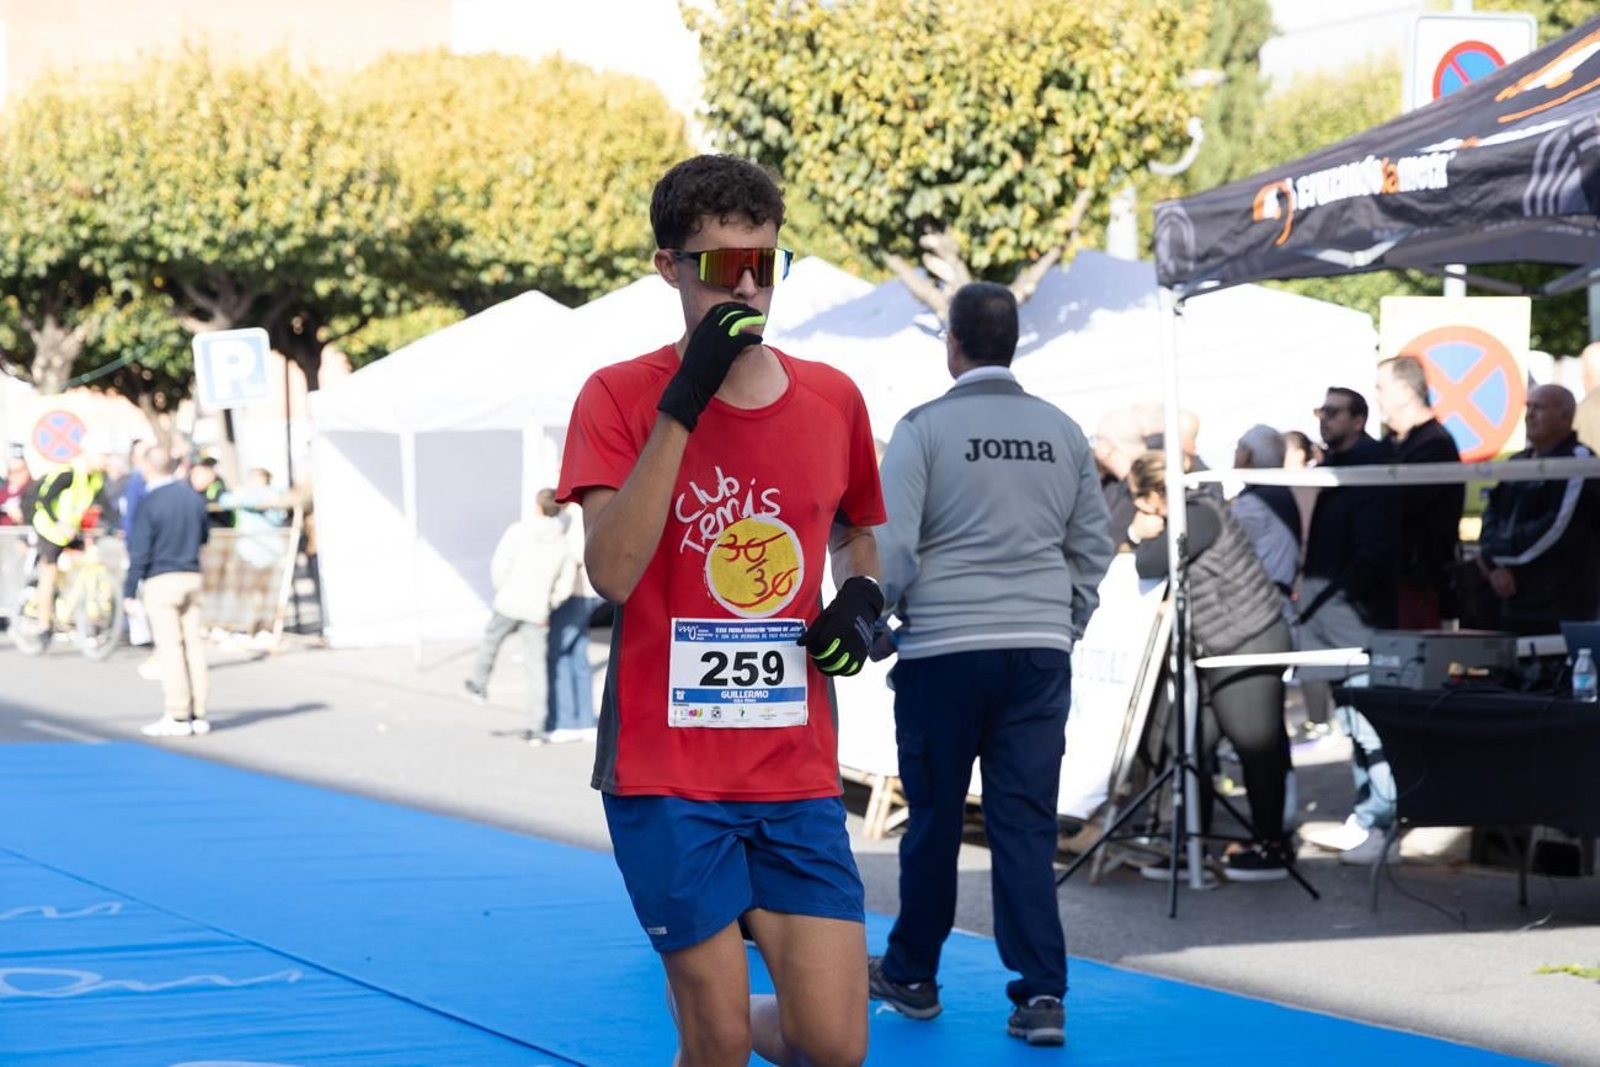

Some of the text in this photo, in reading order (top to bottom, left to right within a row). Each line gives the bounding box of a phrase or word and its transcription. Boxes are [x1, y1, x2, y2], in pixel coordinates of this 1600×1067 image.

[209, 341, 256, 399] P
[965, 438, 1056, 463] Joma
[675, 466, 740, 523] Club
[680, 478, 781, 554] Tenis
[699, 650, 785, 687] 259
[720, 690, 769, 699] GUILLERMO
